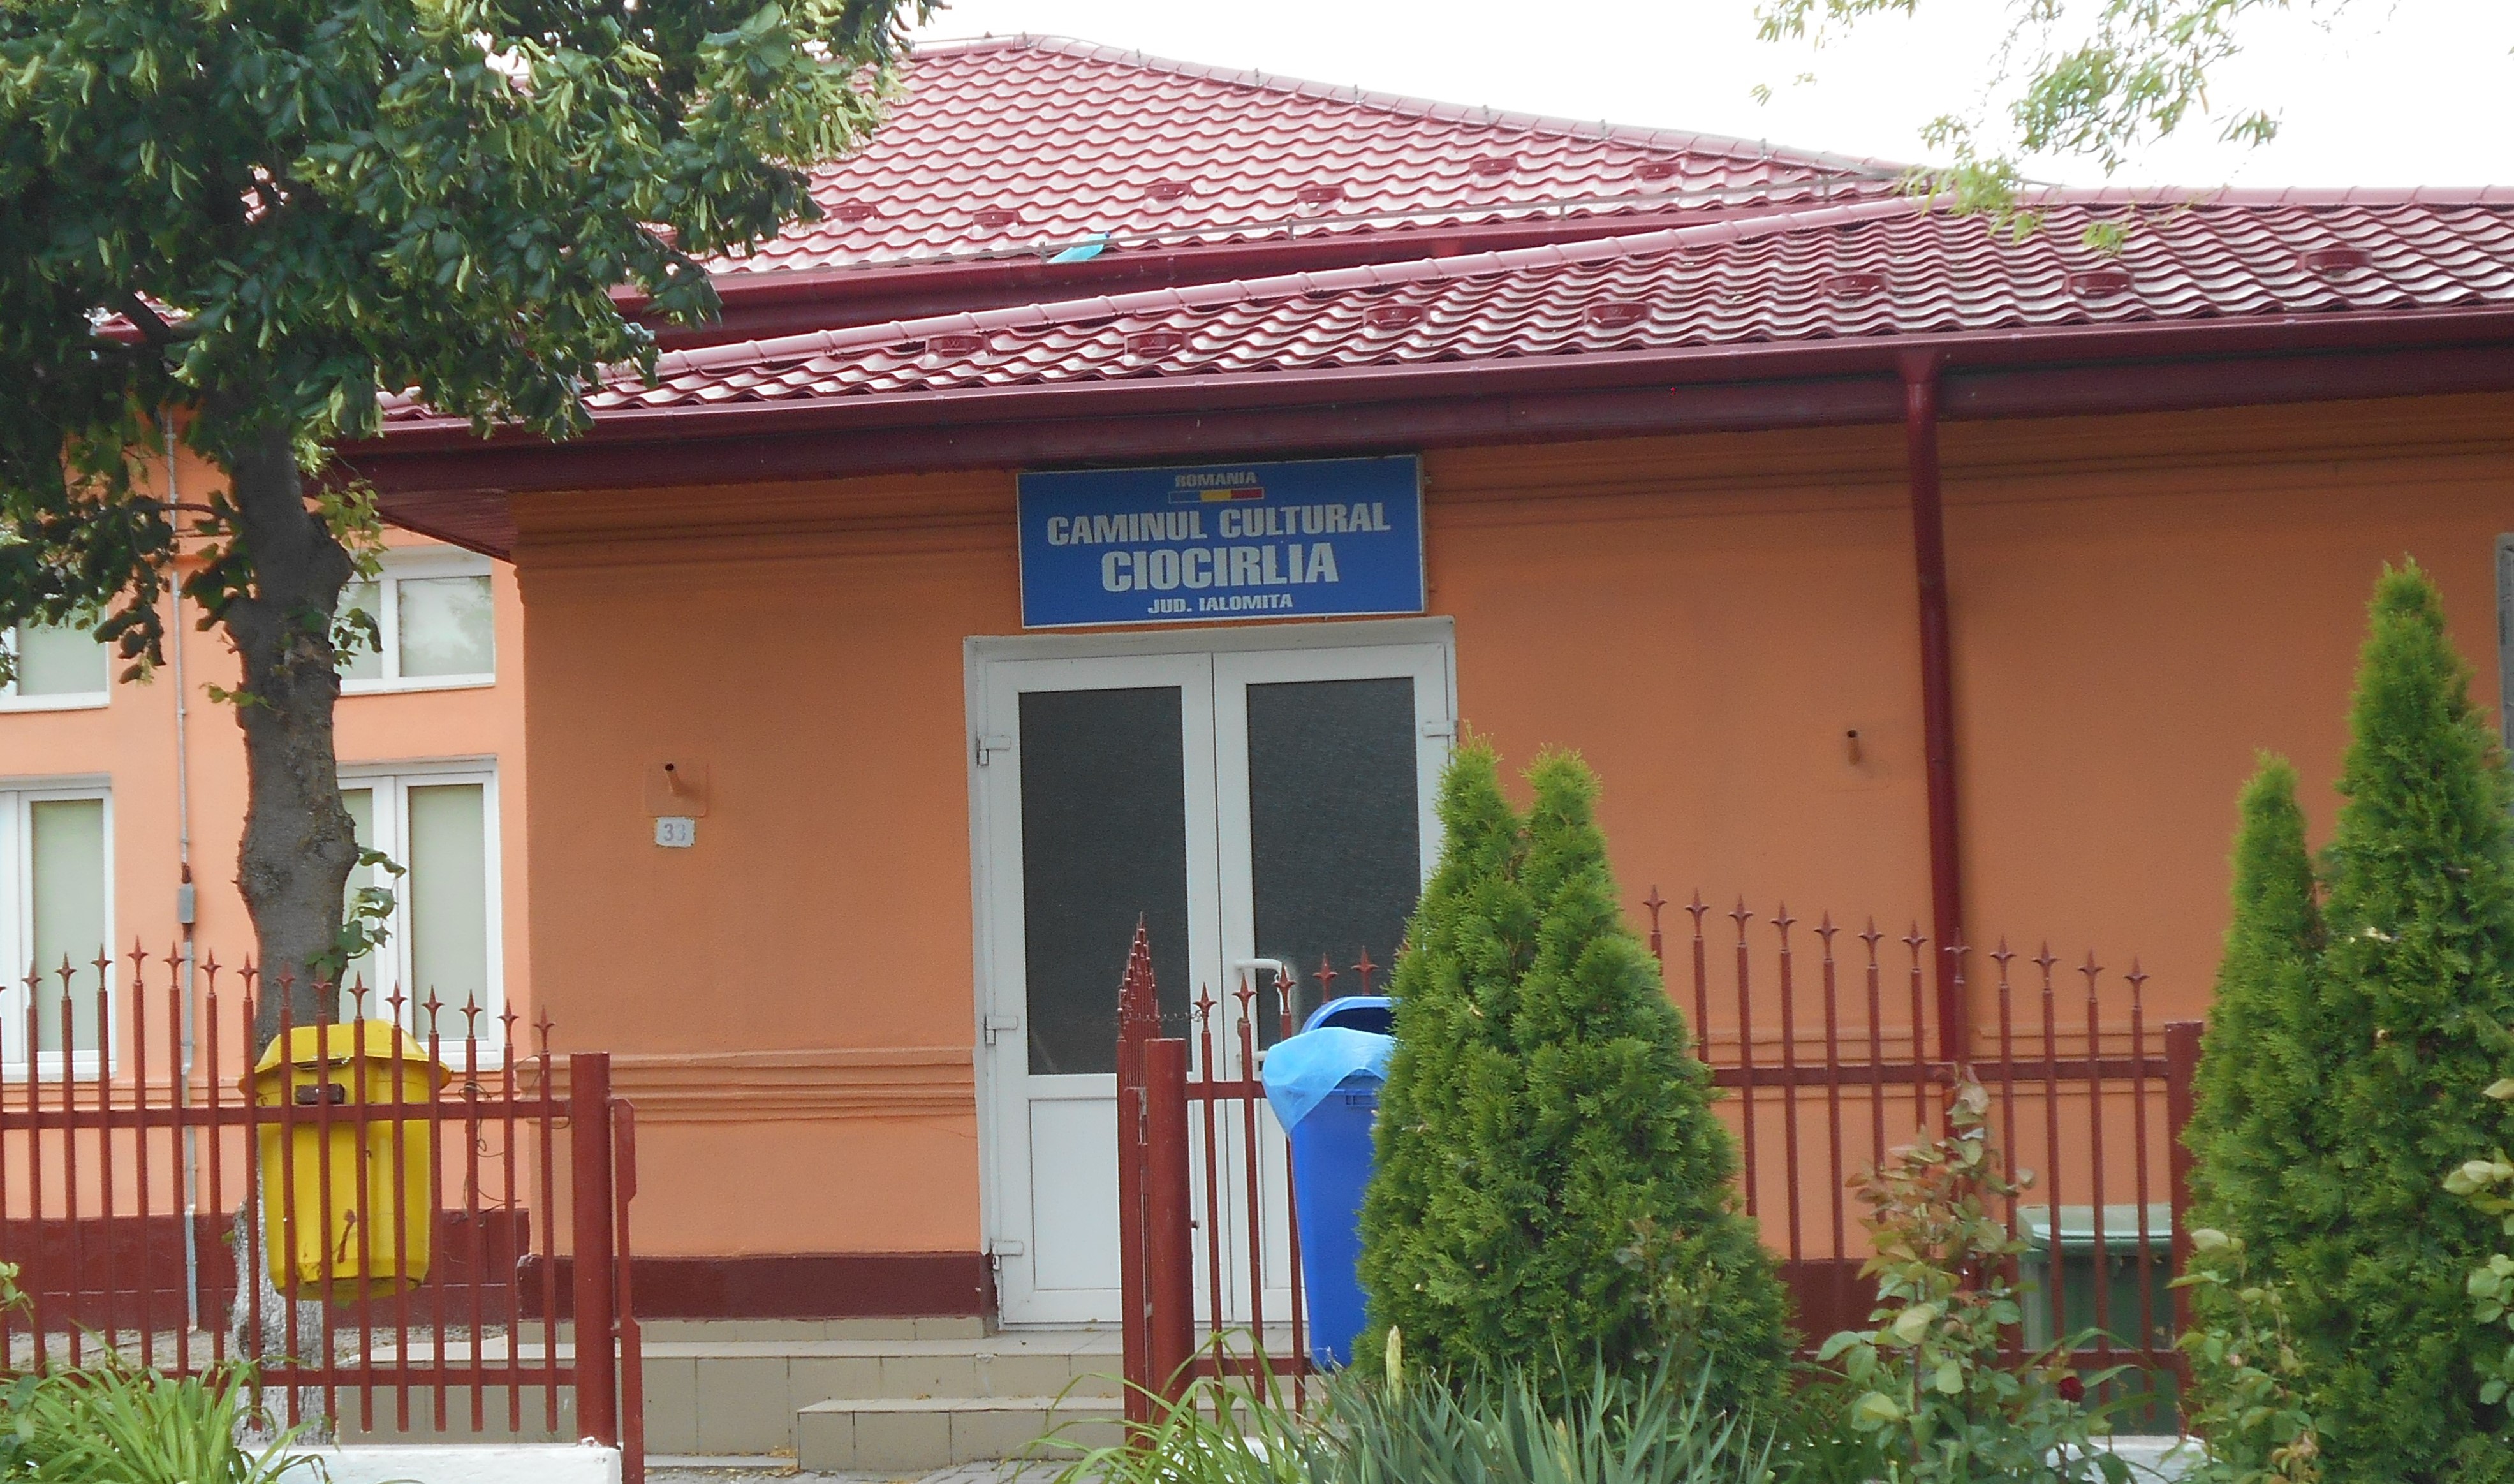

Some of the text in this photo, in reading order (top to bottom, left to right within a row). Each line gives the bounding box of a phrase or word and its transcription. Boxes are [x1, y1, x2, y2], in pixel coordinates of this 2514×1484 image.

[1175, 471, 1257, 487] ROMANIA
[1048, 503, 1390, 545] CAMINUL CULTURAL
[1101, 543, 1339, 592] CIOCIRLIA
[1148, 594, 1293, 613] JUD. IALOMITA
